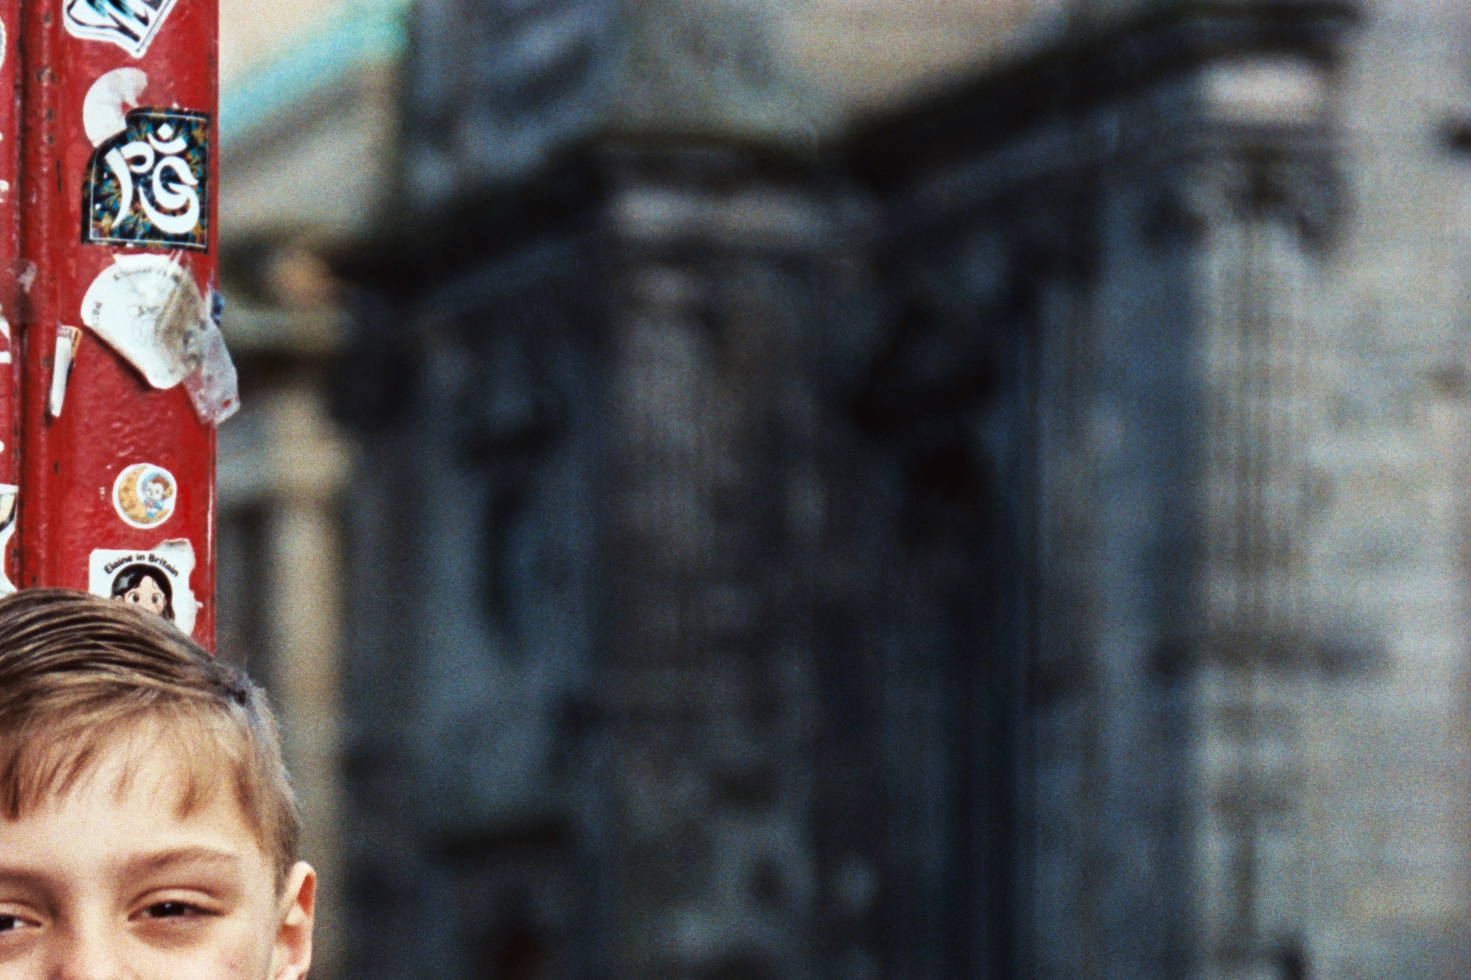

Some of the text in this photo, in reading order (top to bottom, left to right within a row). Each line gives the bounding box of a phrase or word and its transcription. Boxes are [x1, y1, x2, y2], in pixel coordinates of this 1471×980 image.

[104, 553, 178, 577] Elaine in Britain
